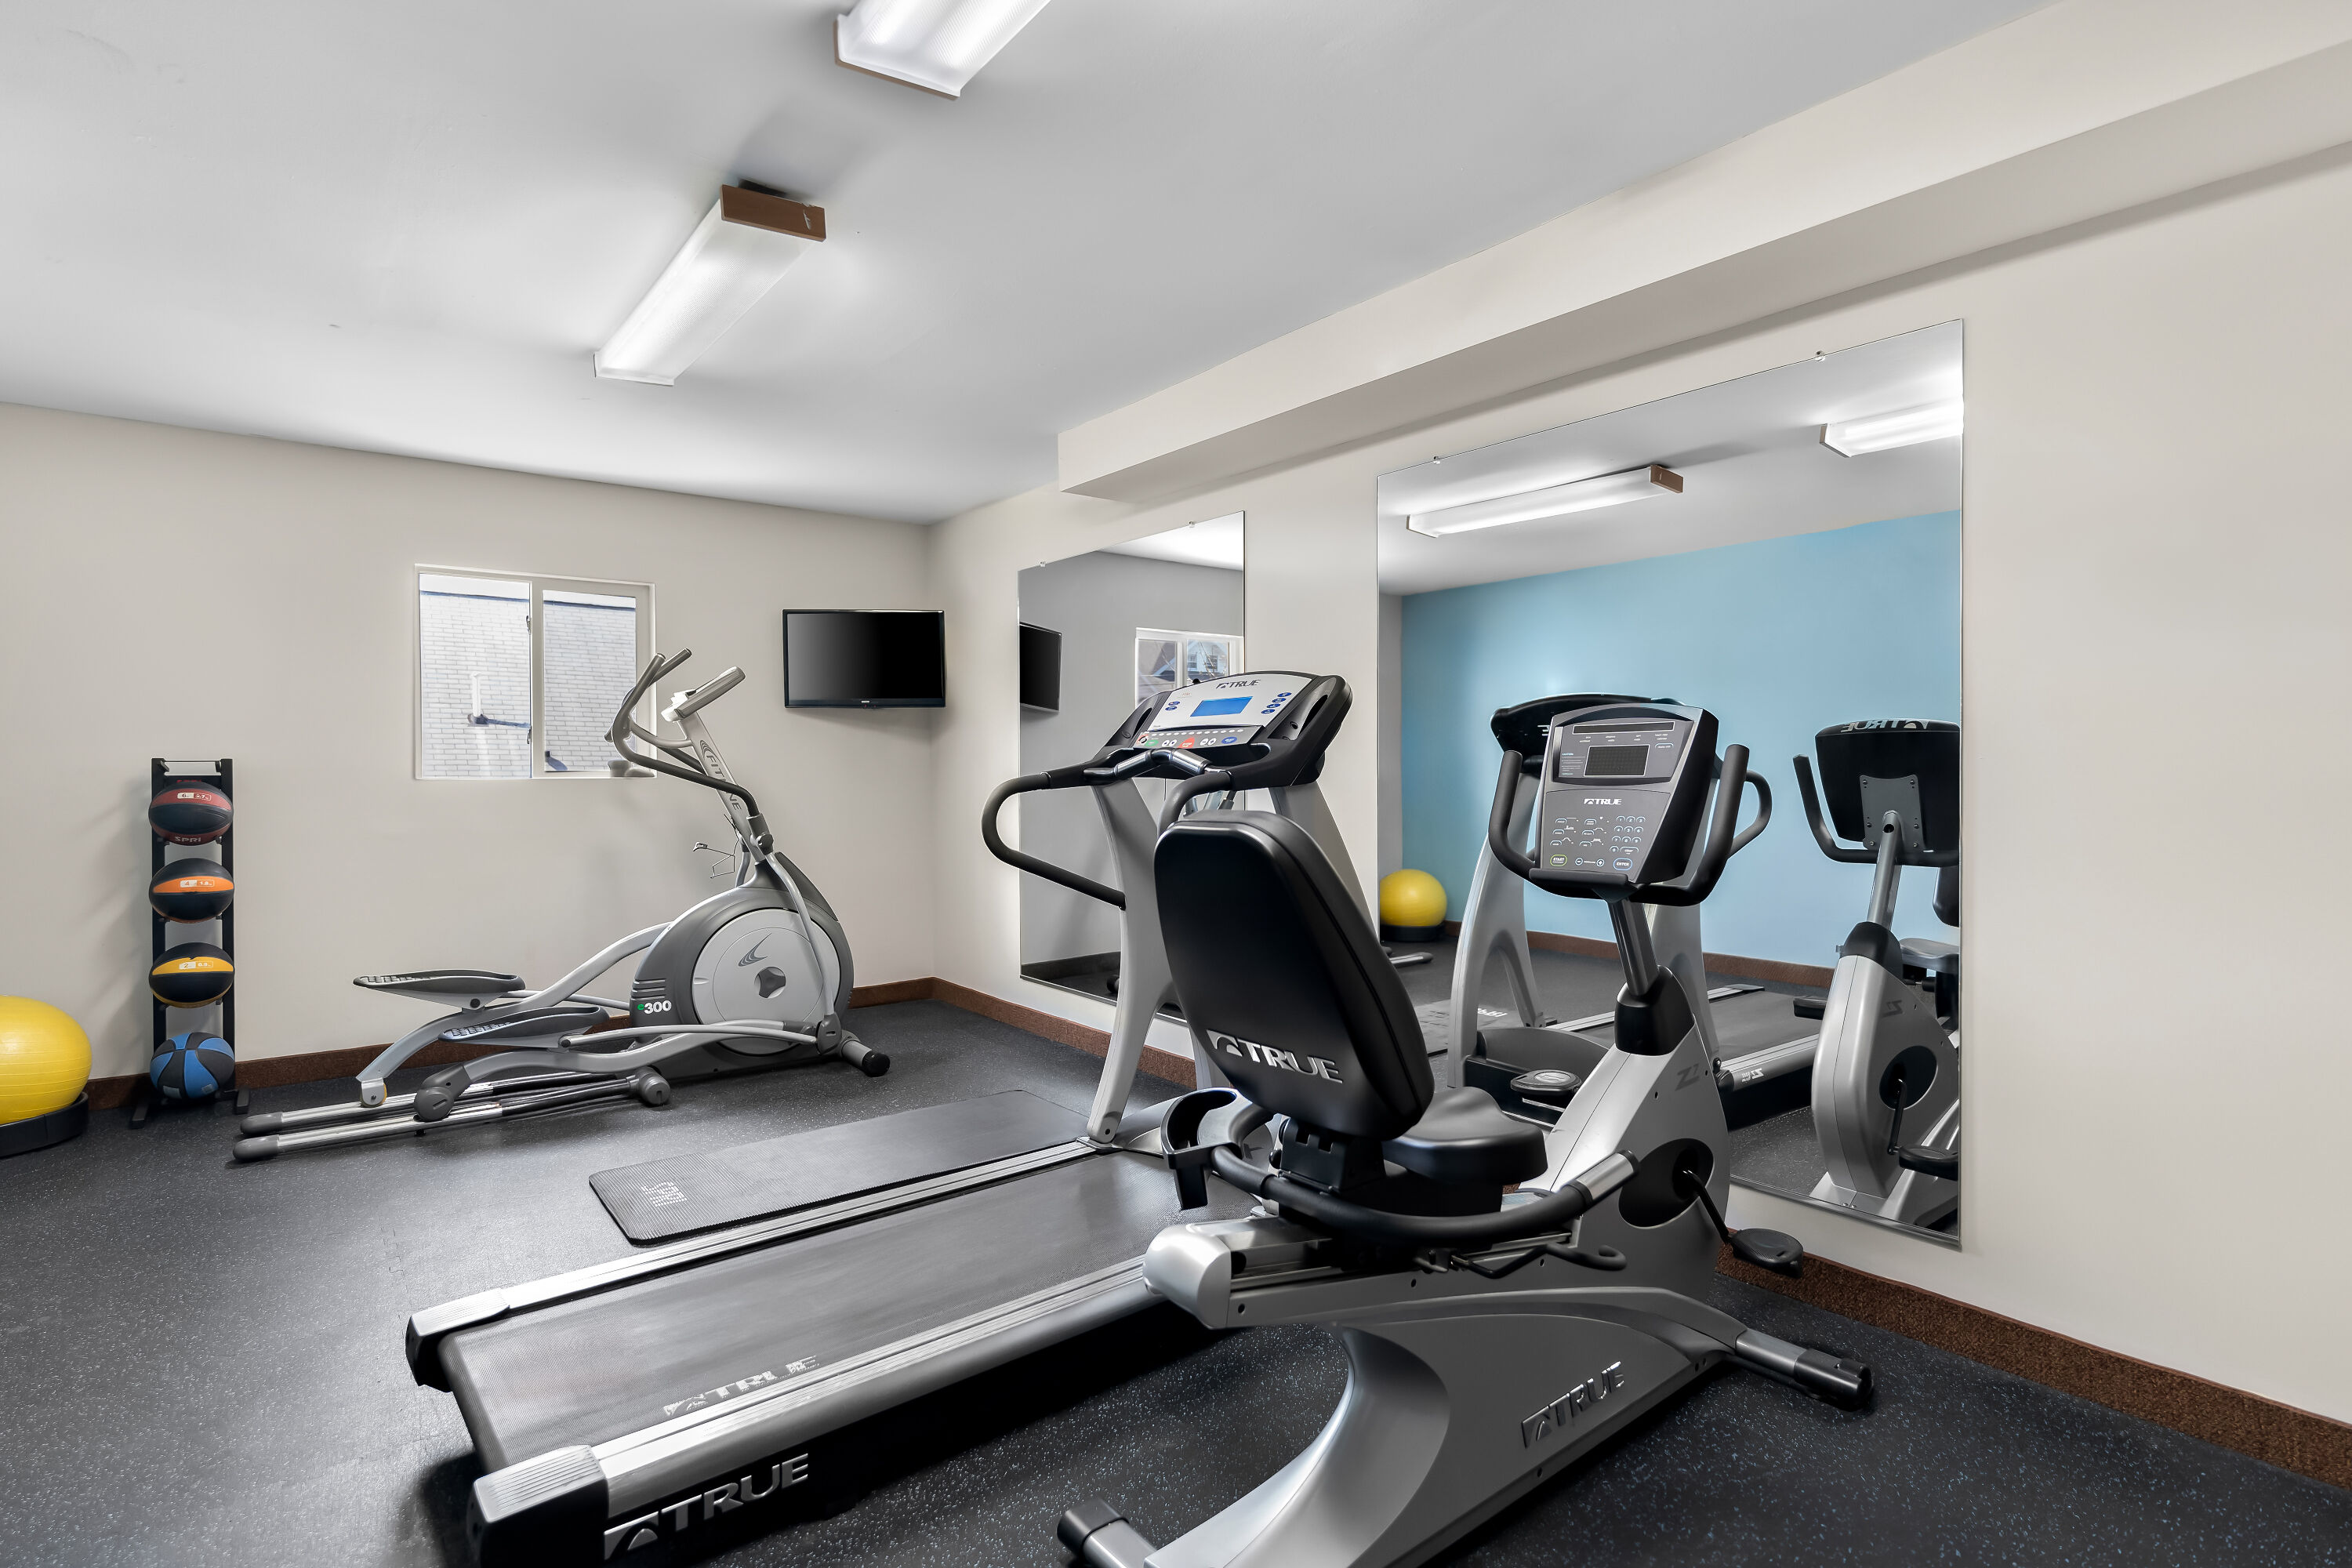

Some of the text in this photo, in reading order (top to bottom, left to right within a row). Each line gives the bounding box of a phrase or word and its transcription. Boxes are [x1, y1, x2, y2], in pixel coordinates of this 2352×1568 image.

[1229, 679, 1261, 688] TRUE
[706, 754, 742, 811] FITNE
[637, 1000, 672, 1014] e300
[1236, 1037, 1343, 1084] TRUE
[1548, 1360, 1624, 1427] TRUE
[661, 1453, 808, 1531] TRUE
